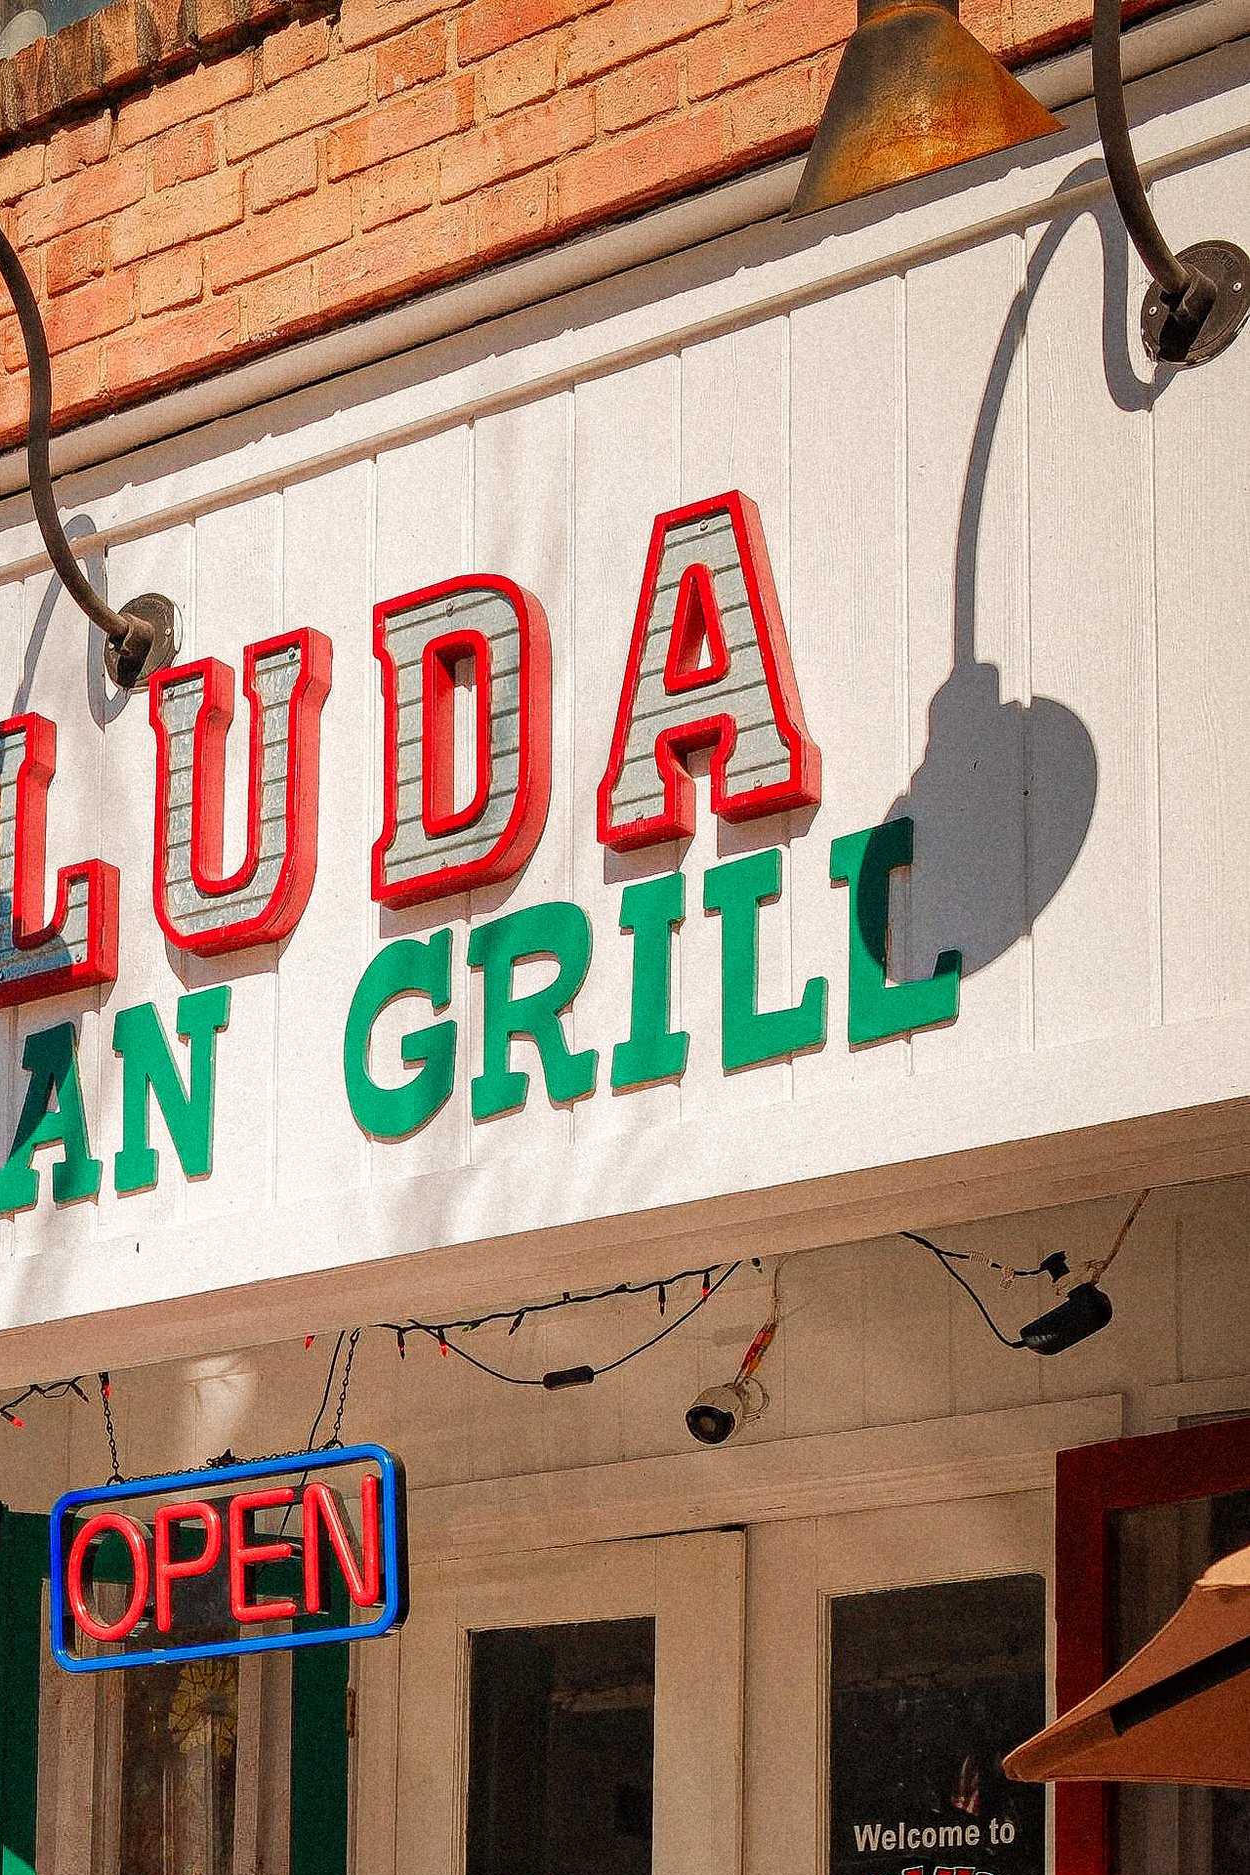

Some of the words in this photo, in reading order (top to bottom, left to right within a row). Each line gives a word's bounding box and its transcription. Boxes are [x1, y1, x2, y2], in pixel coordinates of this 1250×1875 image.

[345, 816, 961, 1140] GRILL
[68, 1471, 380, 1642] OPEN
[853, 1822, 981, 1851] Welcome
[989, 1818, 1016, 1844] to
